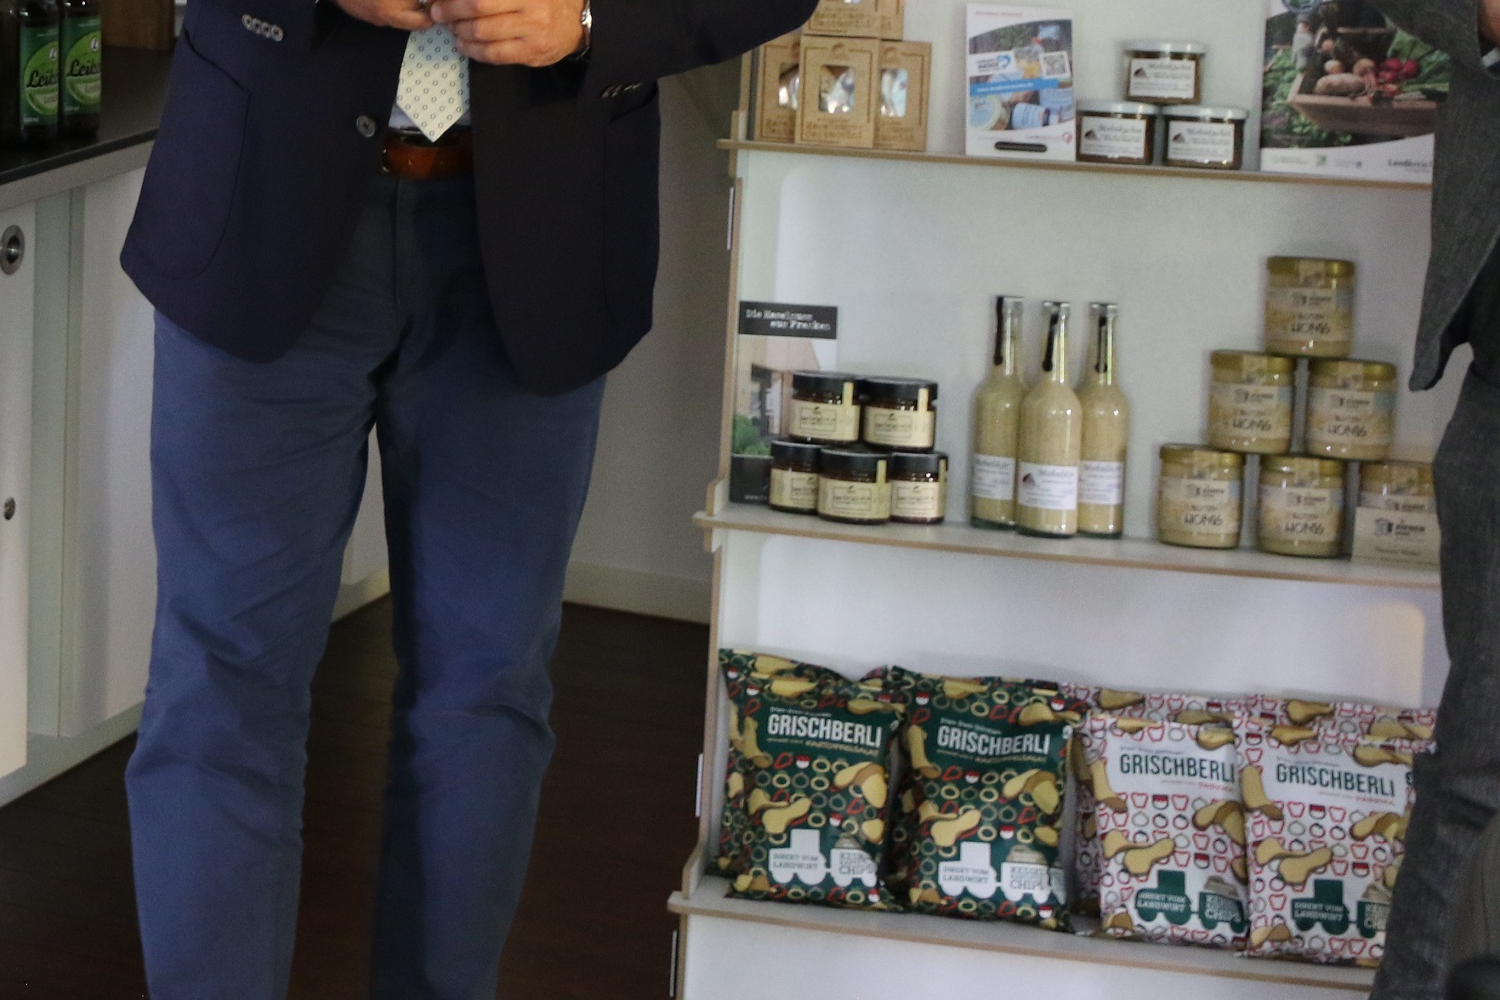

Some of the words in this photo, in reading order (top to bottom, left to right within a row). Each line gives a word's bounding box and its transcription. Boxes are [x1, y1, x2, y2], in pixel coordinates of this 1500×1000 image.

[768, 714, 882, 748] GRISCHBERLI
[937, 725, 1051, 755] GRISCHBERLI
[1120, 754, 1235, 783] GRISCHBERLI
[1276, 763, 1395, 797] GRISCHBERLI
